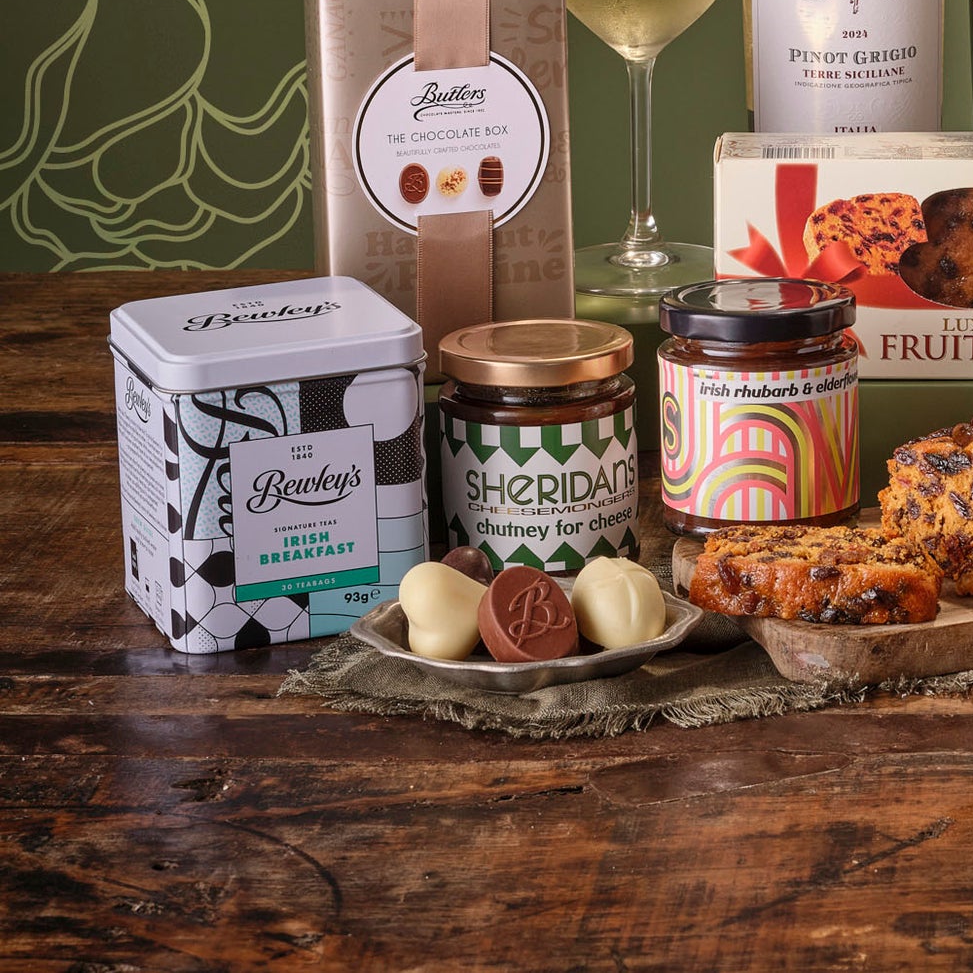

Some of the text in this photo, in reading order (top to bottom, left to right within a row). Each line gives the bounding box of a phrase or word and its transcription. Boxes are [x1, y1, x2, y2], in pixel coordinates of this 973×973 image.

[842, 29, 868, 39] 2024
[788, 45, 918, 65] PINOT GRIGIO
[803, 66, 905, 79] TERRE SICILIANE
[794, 77, 913, 89] INDICAZIONE GEOGRAFICA TIPICA
[410, 82, 487, 110] Butlers
[387, 125, 508, 144] THE CHOCOLATE BOX
[834, 125, 877, 133] ITALIA
[396, 143, 501, 157] BEAUTIFULLY CRAFTED CHOCOLATES
[182, 301, 342, 332] Bewley's
[699, 382, 730, 397] irish
[733, 383, 799, 398] rhubarb
[802, 382, 813, 395] &
[291, 444, 313, 453] ESTD
[291, 452, 313, 461] 1840
[246, 463, 361, 514] Bewley's
[468, 488, 636, 516] CHEESEMONGERS
[274, 519, 337, 533] SIGNATURE TEAS
[476, 505, 633, 541] chutney for cheese
[283, 531, 329, 548] IRISH
[259, 542, 355, 566] BREAKFAST
[296, 577, 336, 589] TEABAGS
[344, 592, 369, 604] 93g
